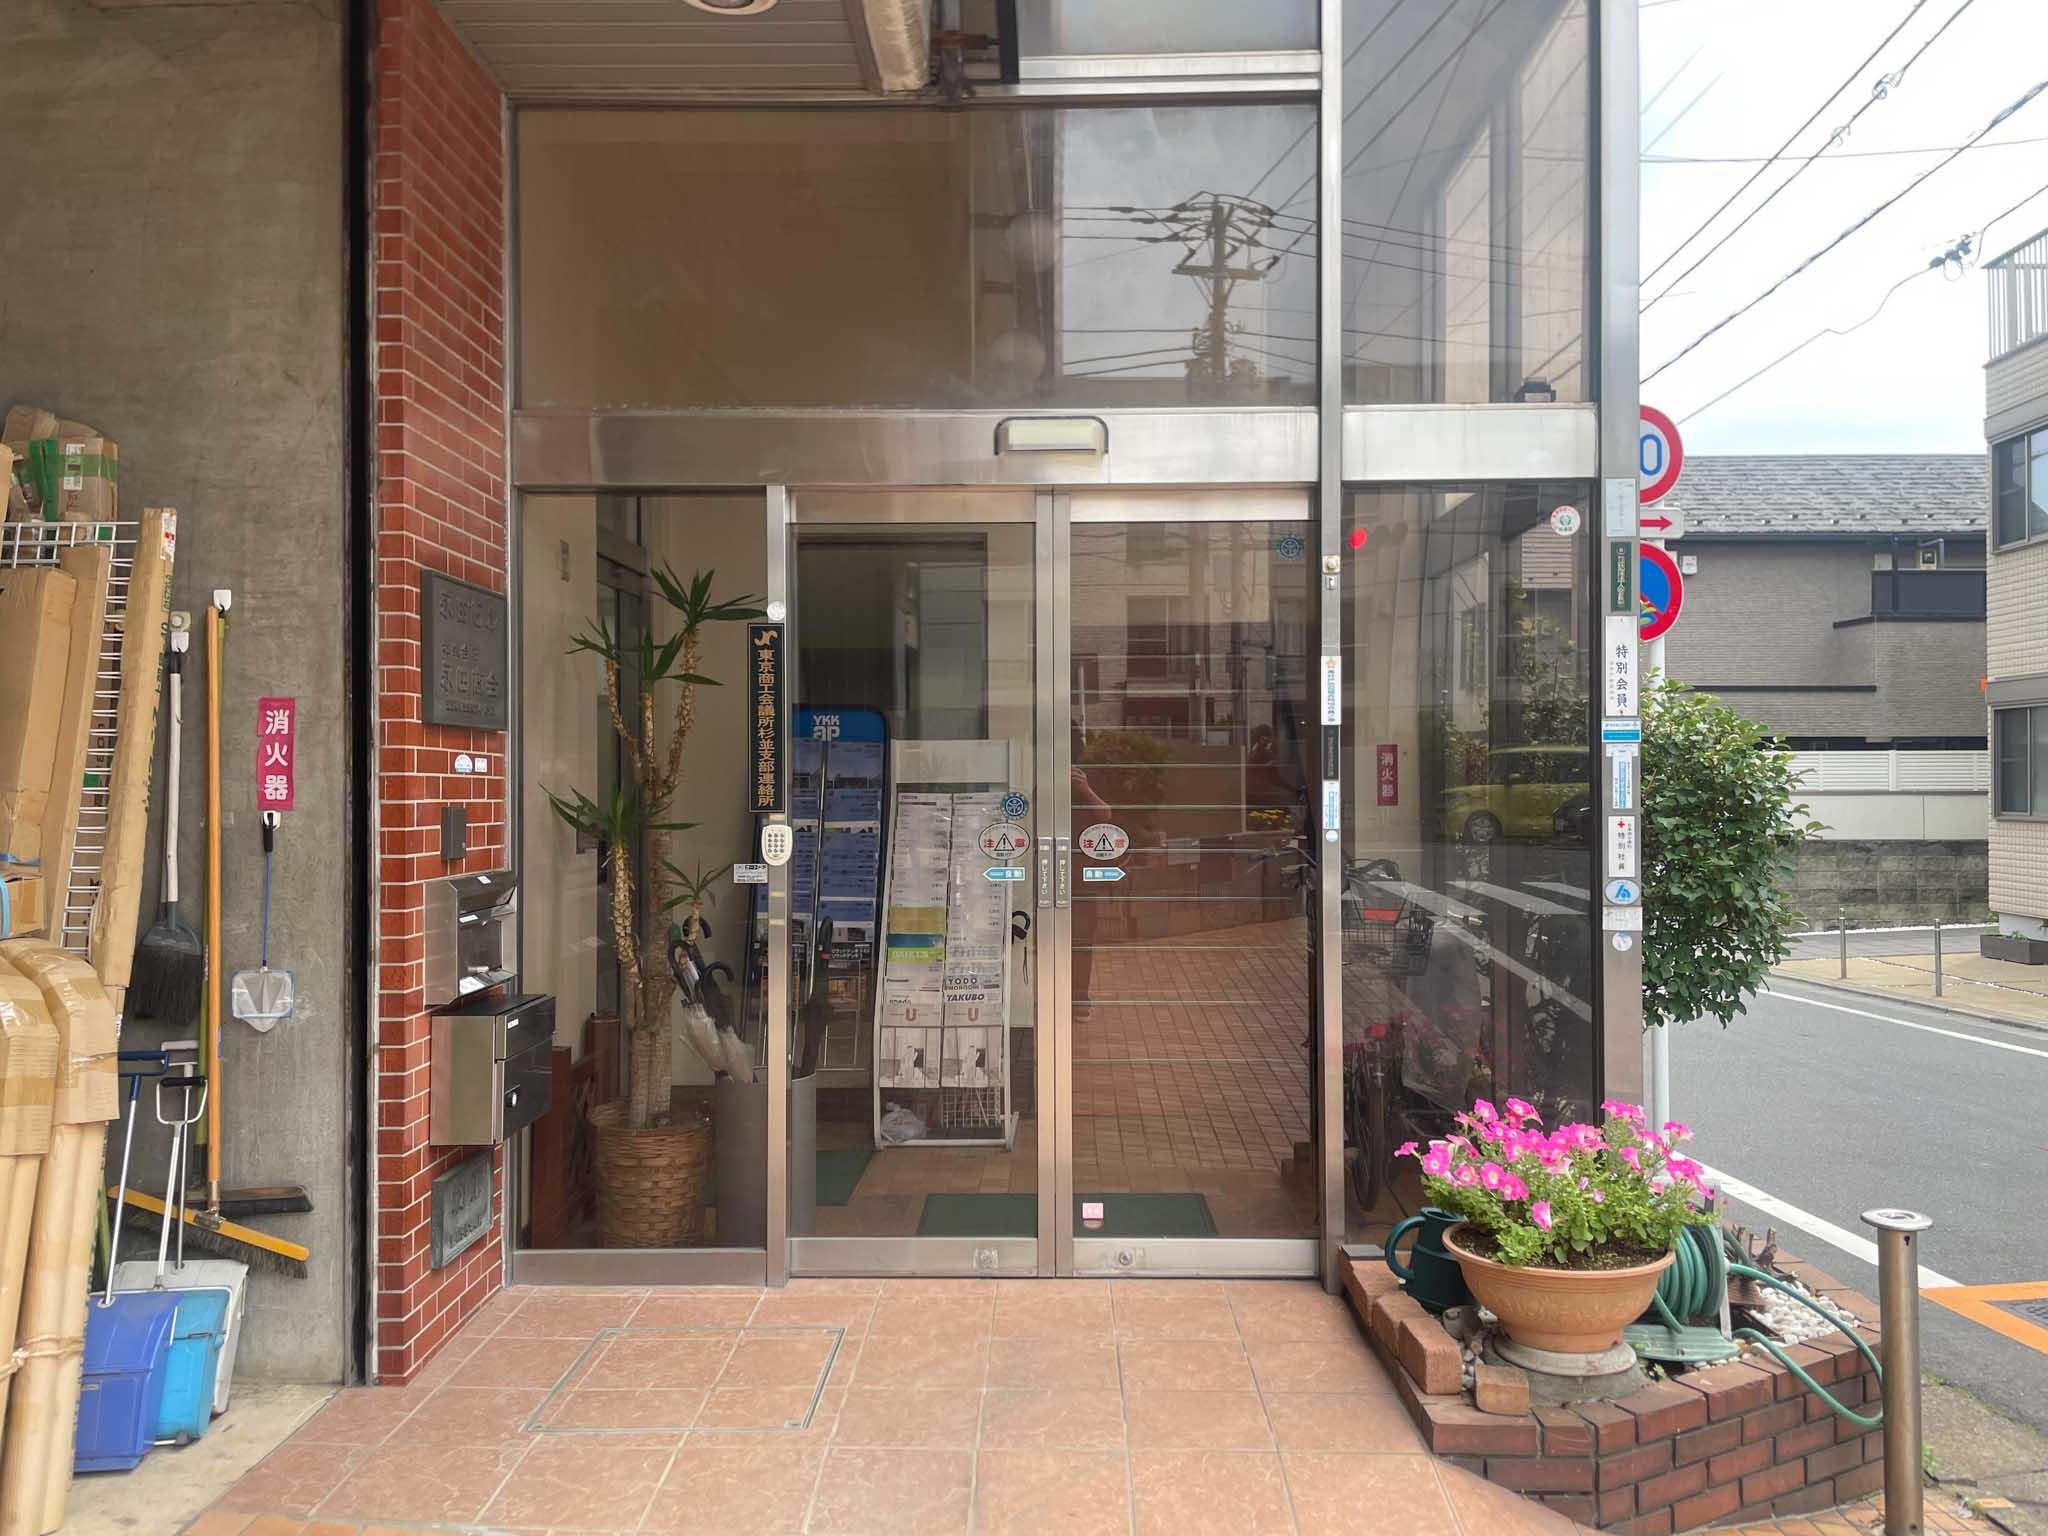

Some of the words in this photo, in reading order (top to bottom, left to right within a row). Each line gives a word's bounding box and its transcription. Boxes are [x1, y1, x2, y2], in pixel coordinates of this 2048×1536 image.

[1616, 644, 1628, 708] 特別会員
[758, 649, 775, 807] 東京商工会議所杉並支部連絡所
[813, 715, 840, 726] YKK
[813, 726, 840, 741] ap
[265, 709, 289, 800] 消火器
[1381, 753, 1393, 797] 消火器
[948, 977, 977, 985] YODO
[947, 993, 985, 1001] TAKUBO
